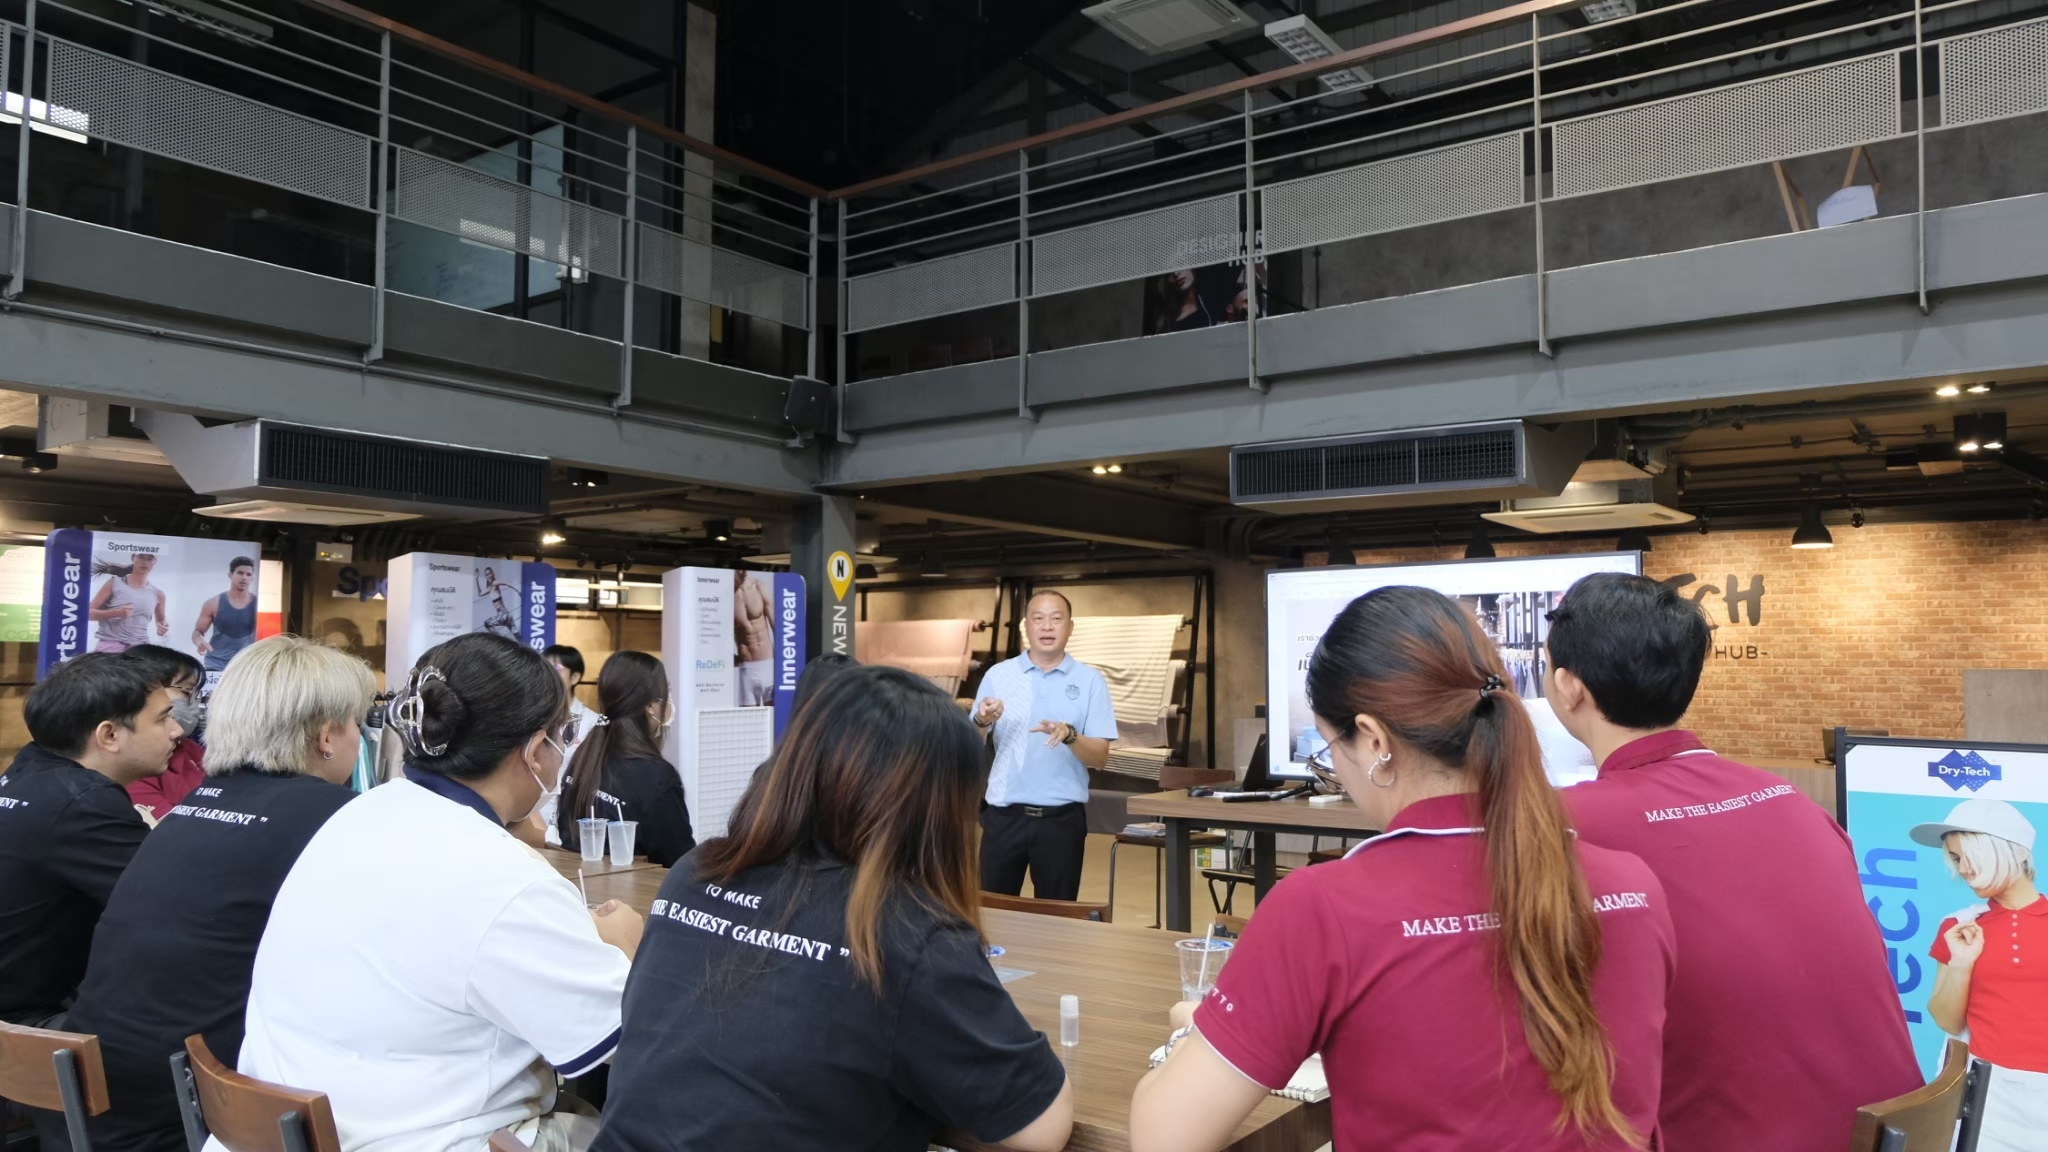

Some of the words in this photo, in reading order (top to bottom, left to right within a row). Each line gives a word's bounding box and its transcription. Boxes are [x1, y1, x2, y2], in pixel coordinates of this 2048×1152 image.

[108, 541, 160, 553] Sportswear
[429, 563, 460, 572] Sportswear
[836, 559, 845, 578] N
[56, 552, 81, 662] rtswear
[530, 581, 546, 654] swear
[779, 588, 797, 690] Innerwear
[1938, 765, 1991, 778] Dry-Tech
[195, 807, 256, 826] GARMENT
[1645, 807, 1685, 822] MAKE
[1683, 804, 1708, 818] THE
[1706, 795, 1752, 814] EASIEST
[1751, 784, 1797, 803] GARMENT
[724, 890, 762, 909] MAKE
[1401, 916, 1462, 937] MAKE
[1463, 912, 1502, 931] THE
[1592, 892, 1649, 913] ARMENT
[668, 902, 732, 936] EASIEST
[732, 925, 831, 961] GARMENT
[1858, 848, 1923, 1024] ech
